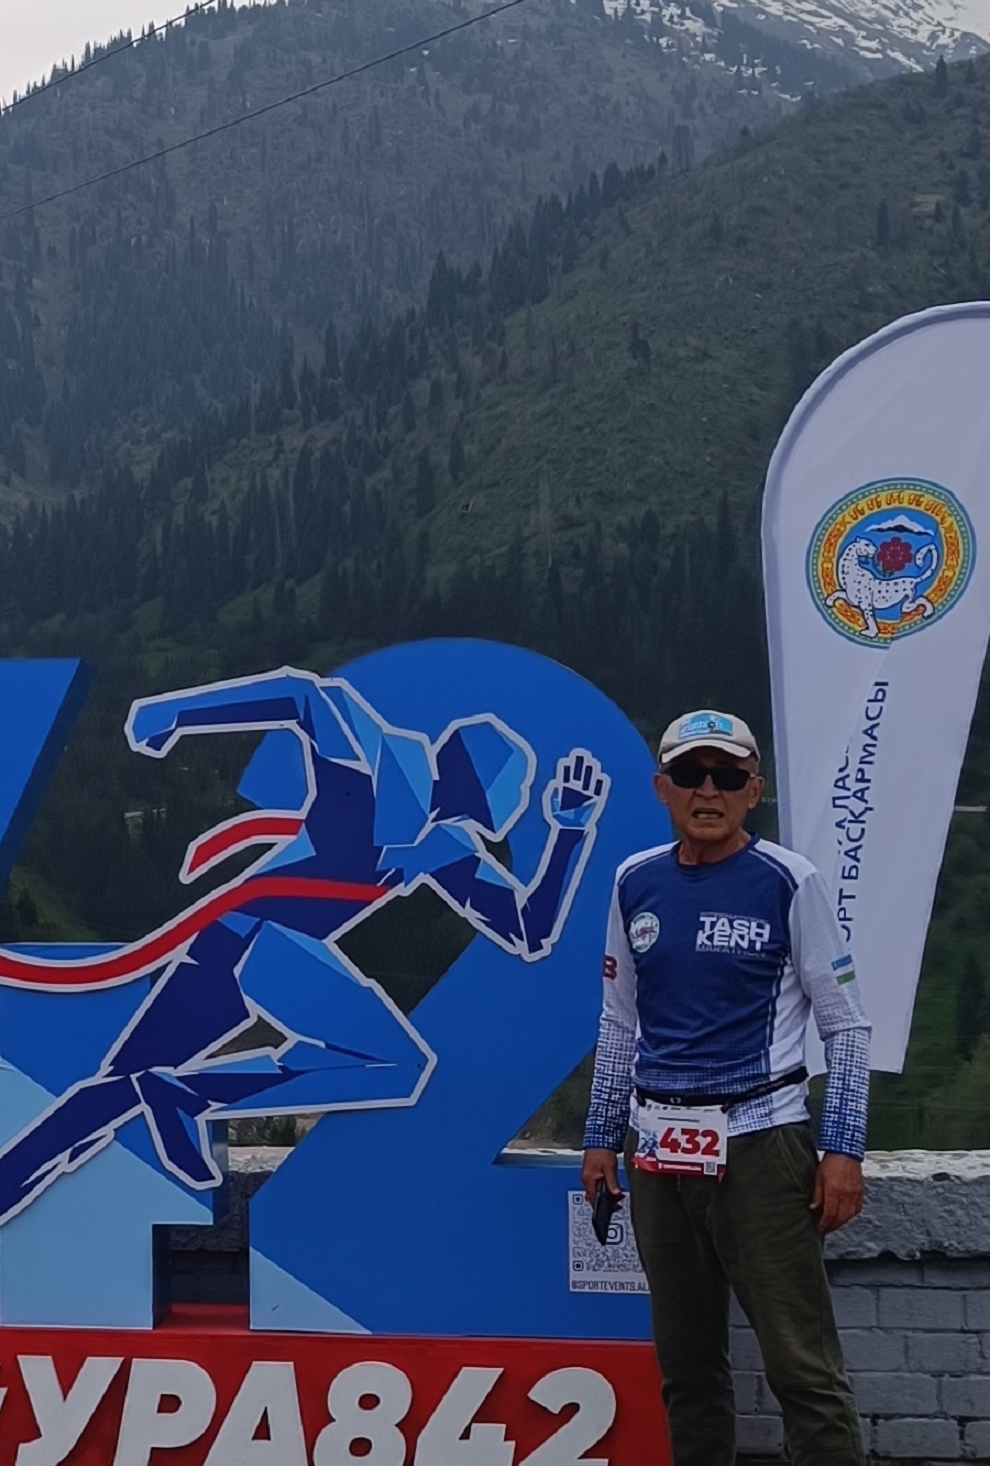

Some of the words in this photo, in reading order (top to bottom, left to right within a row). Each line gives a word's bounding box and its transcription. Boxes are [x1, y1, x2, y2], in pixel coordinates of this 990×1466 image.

[840, 681, 889, 881] БАСҚАРМАСЫ
[832, 745, 852, 855] АЛА
[696, 929, 769, 951] KENT
[699, 917, 771, 942] TASH
[659, 1127, 720, 1158] 432
[571, 1279, 650, 1292] @SPORTEVENTS.AL
